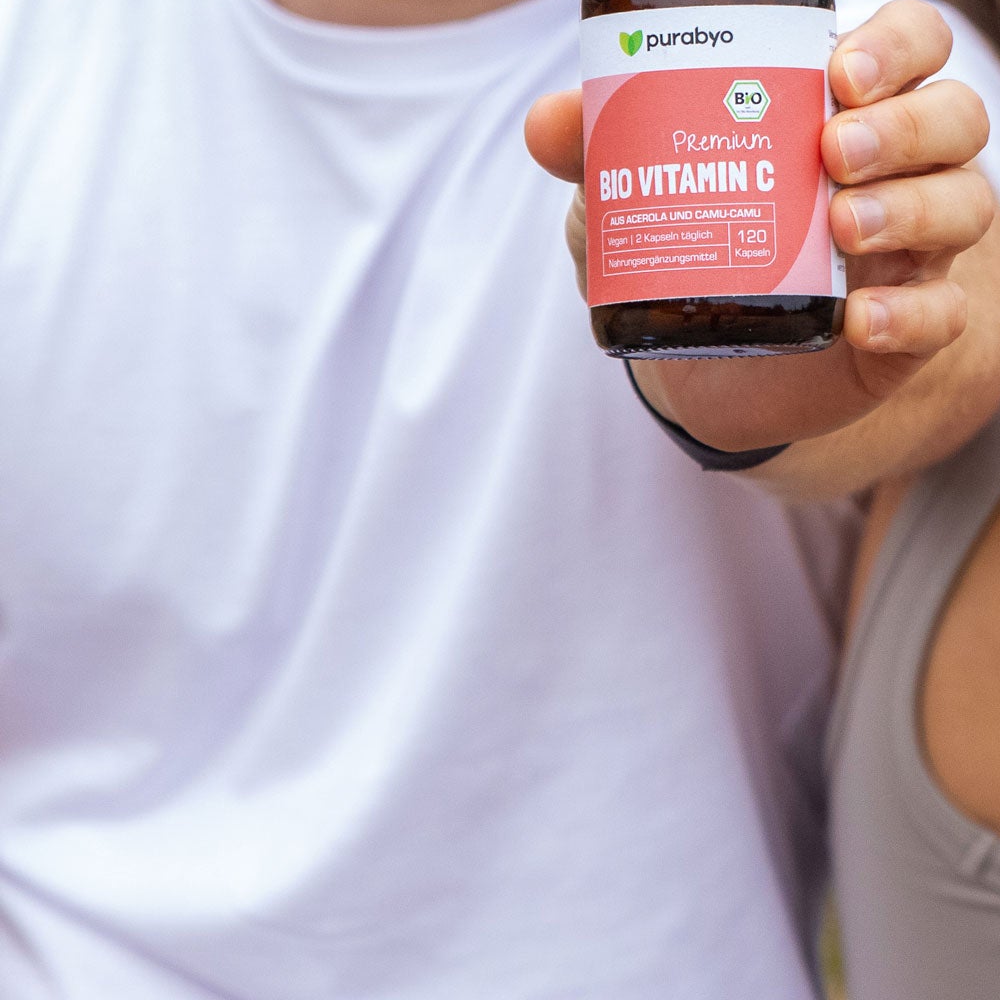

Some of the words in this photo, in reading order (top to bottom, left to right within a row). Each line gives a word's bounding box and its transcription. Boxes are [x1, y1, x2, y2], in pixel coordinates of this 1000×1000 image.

[646, 27, 734, 51] purabyo
[600, 169, 632, 201] BIO
[638, 160, 748, 197] VITAMIN
[756, 160, 775, 192] C
[610, 216, 625, 226] AUS
[626, 213, 667, 225] ACEROLA
[669, 210, 693, 221] UND
[695, 209, 761, 220] CAMU-CAMU
[607, 237, 628, 247] Vegan
[635, 233, 642, 244] 2
[643, 231, 679, 244] Kapseln
[681, 230, 713, 242] täglich
[737, 230, 767, 243] 120
[608, 251, 717, 268] Nahrungsergänzungsmittel
[735, 248, 771, 259] Kapseln
